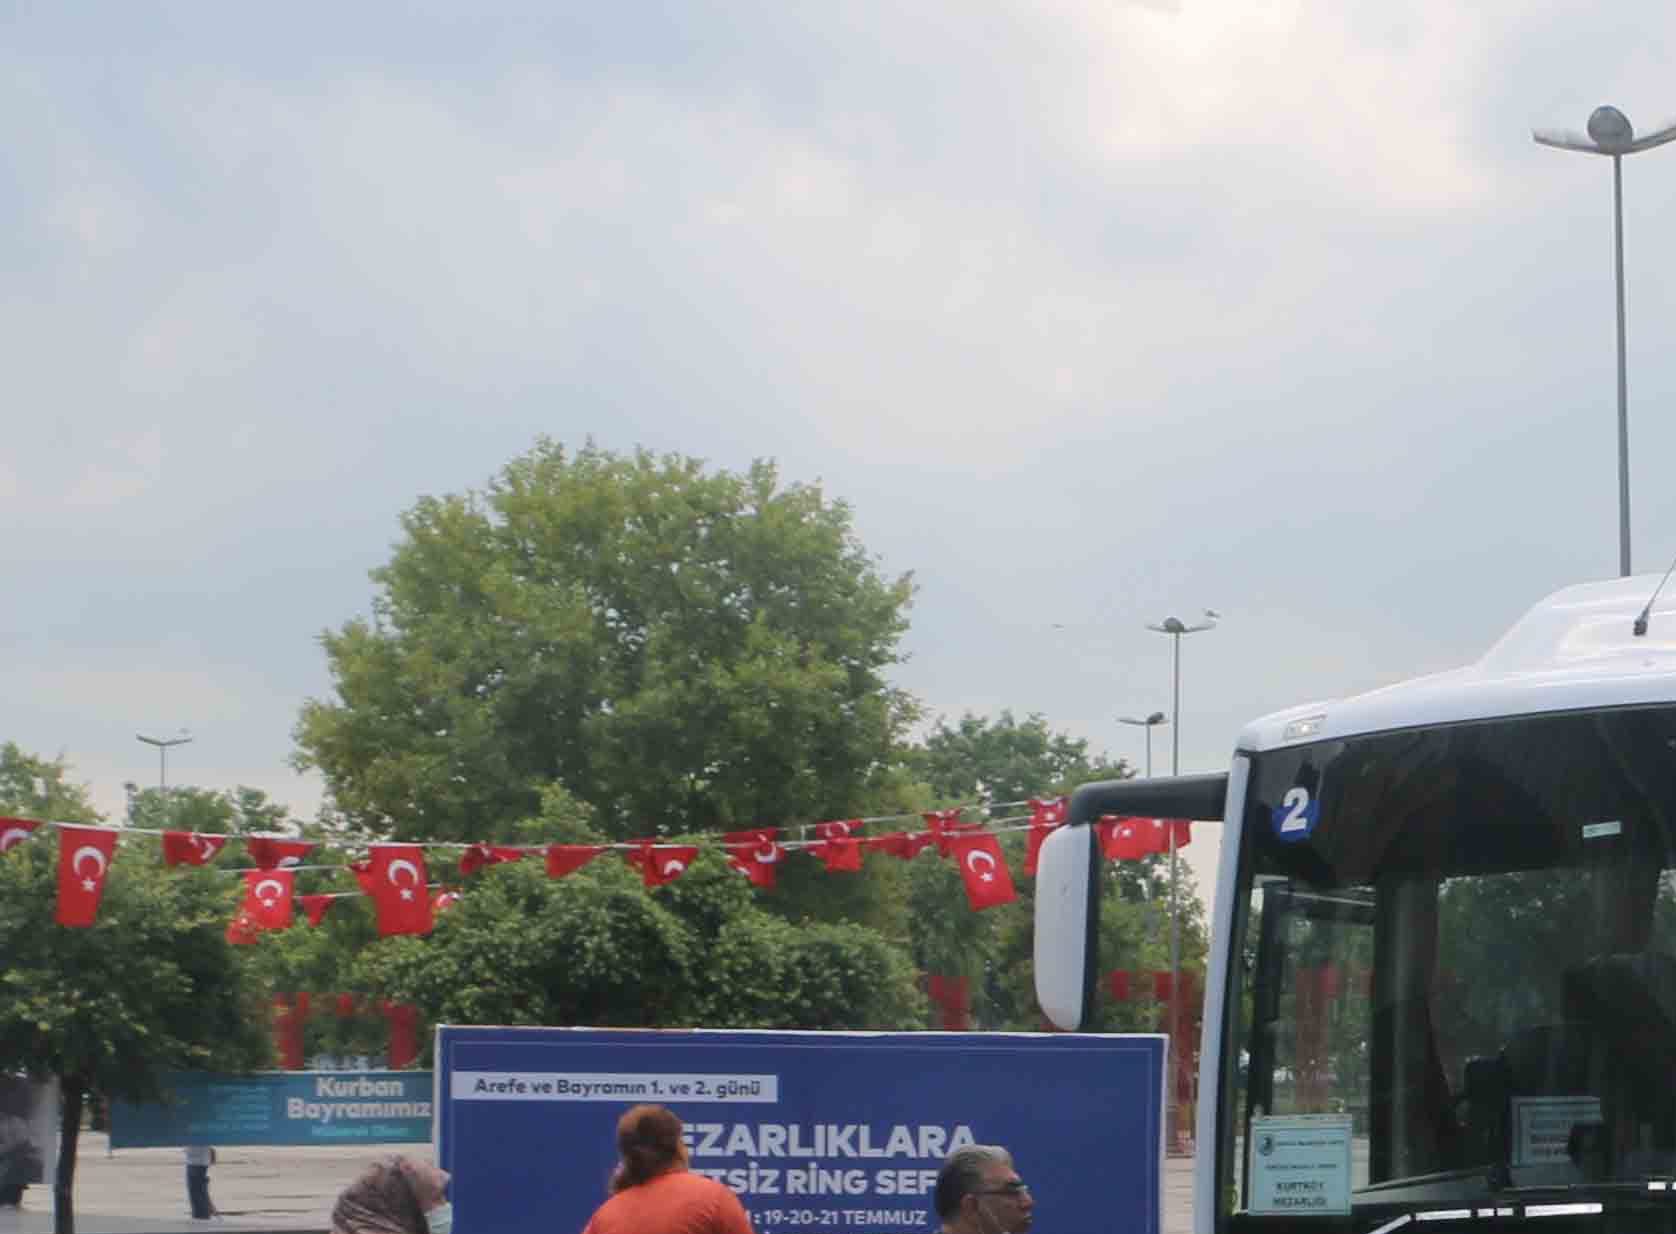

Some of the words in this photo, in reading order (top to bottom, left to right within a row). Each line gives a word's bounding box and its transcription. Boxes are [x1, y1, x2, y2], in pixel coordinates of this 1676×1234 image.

[1281, 787, 1309, 832] 2
[317, 1076, 404, 1097] Kurban
[474, 1079, 525, 1094] Arefe
[532, 1083, 551, 1094] ve
[557, 1079, 646, 1098] Bayramın
[652, 1080, 664, 1095] 1.
[670, 1084, 690, 1096] ve
[696, 1080, 712, 1096] 2.
[716, 1080, 761, 1098] günü
[288, 1098, 431, 1123] Bayramımız
[680, 1124, 976, 1158] EZARLIKLARA
[786, 1162, 868, 1196] RİNG
[874, 1169, 938, 1196] SEF
[764, 1210, 838, 1226] 19-20-21
[843, 1210, 927, 1226] TEMMUZ
